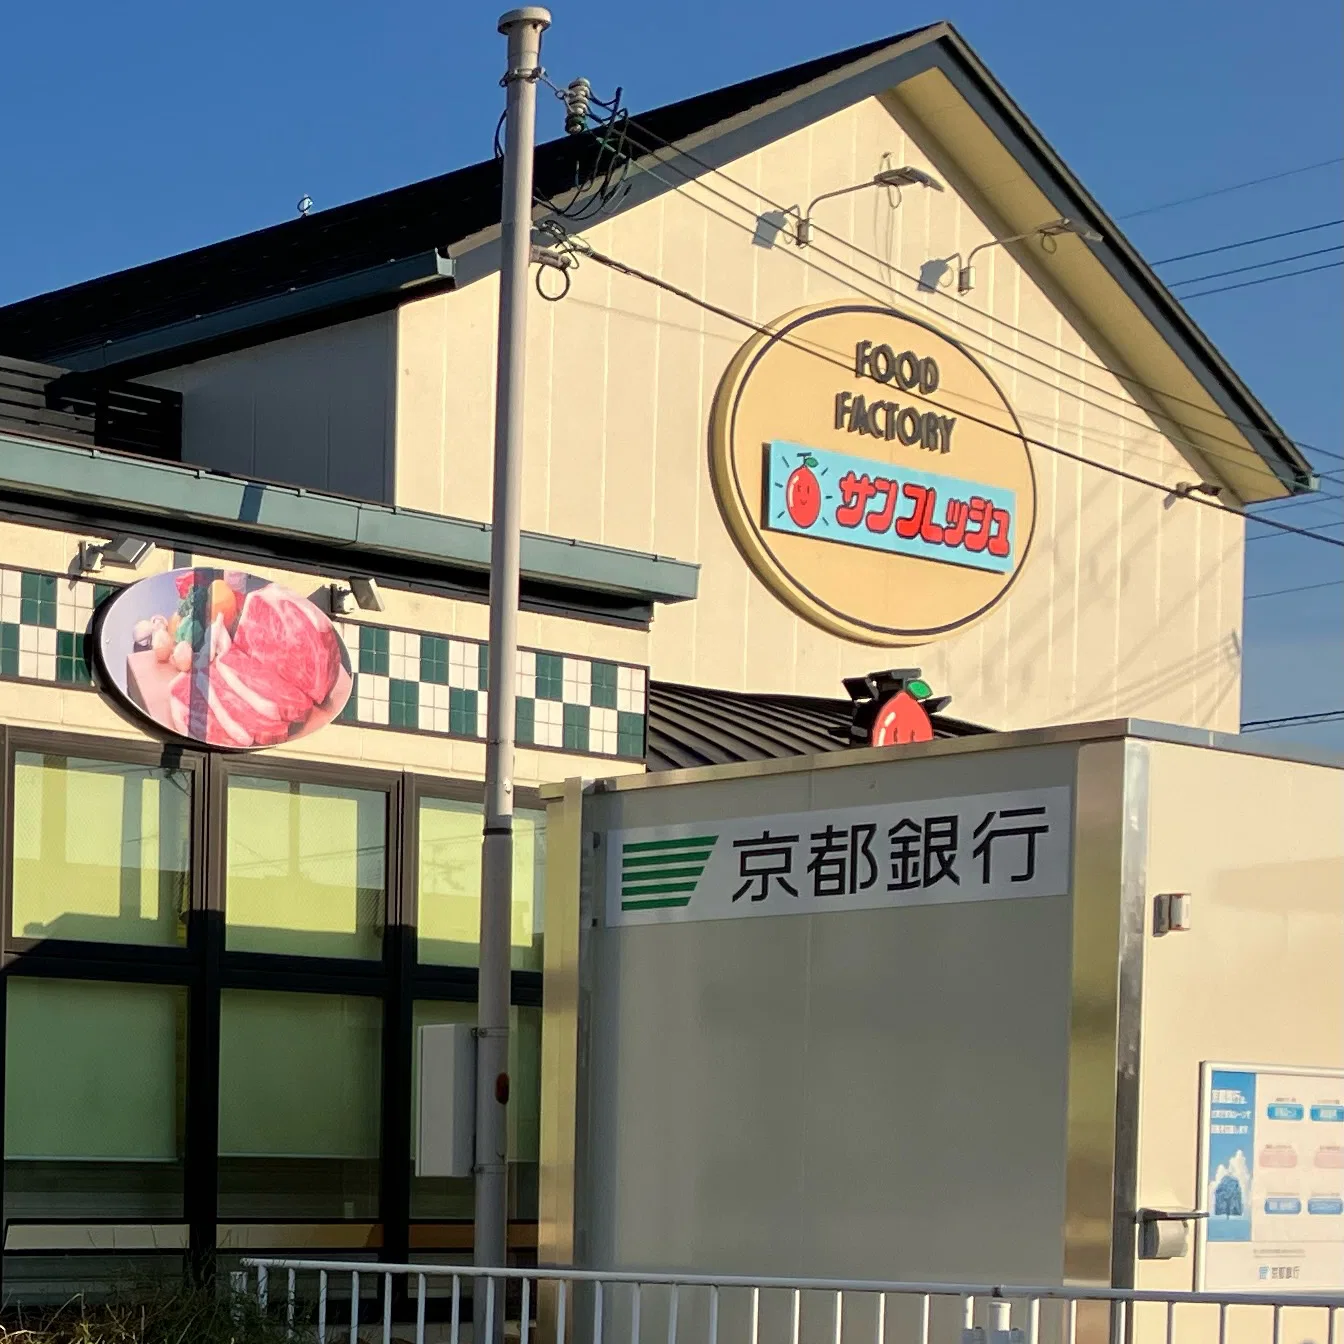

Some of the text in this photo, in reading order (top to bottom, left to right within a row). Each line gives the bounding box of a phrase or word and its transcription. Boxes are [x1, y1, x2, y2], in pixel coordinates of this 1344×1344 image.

[855, 341, 940, 394] FOOD
[834, 391, 957, 454] FACTORY
[836, 470, 1010, 557] サンフレッシュ
[732, 806, 1050, 902] 京都銀行
